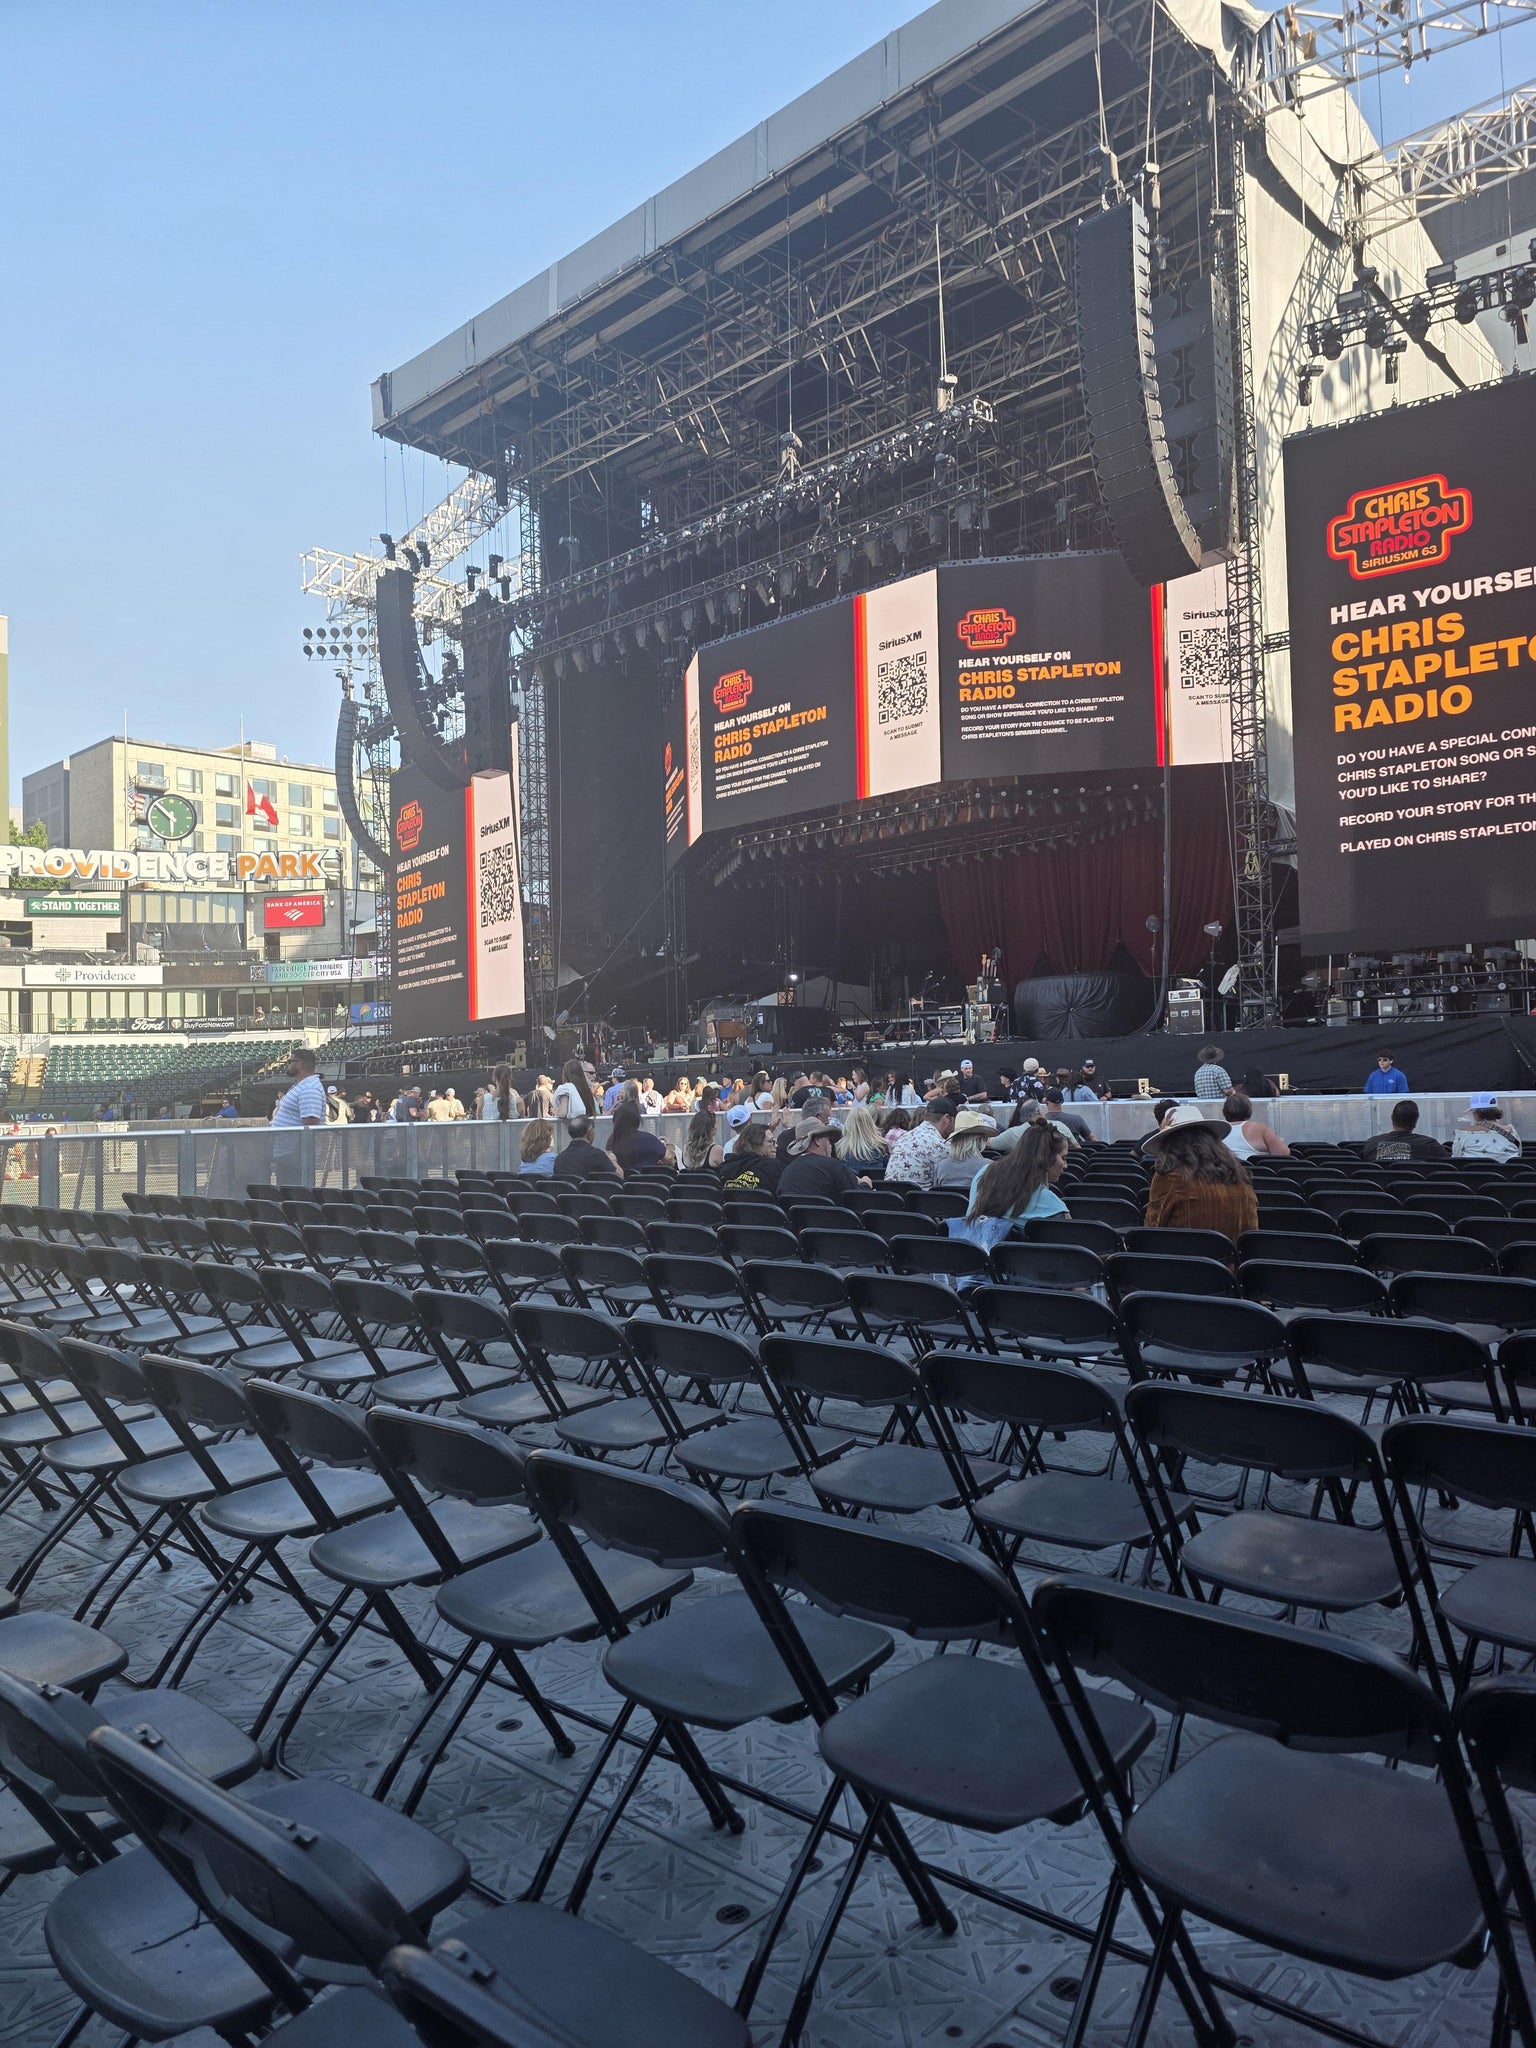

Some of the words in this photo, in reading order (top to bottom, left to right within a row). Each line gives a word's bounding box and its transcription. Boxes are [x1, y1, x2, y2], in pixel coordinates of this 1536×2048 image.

[1365, 487, 1430, 518] CHRIS
[1338, 501, 1459, 547] STAPLETON
[1370, 530, 1430, 556] RADIO
[1362, 550, 1418, 569] SIRIUSXM
[1422, 545, 1437, 556] 63
[1330, 593, 1406, 625] HEAR
[1413, 566, 1536, 608] YOURSE
[962, 621, 1011, 634] STAPLETON
[973, 613, 1000, 623] CHRIS
[878, 630, 922, 650] SiriusXM
[1332, 612, 1465, 662] CHRIS
[959, 658, 990, 668] HEAR
[992, 652, 1052, 665] YOURSELF
[1054, 651, 1071, 661] ON
[1332, 635, 1536, 696] STAPLET
[959, 669, 1013, 686] CHRIS
[1017, 661, 1121, 682] STAPLETON
[959, 685, 1016, 701] RADIO
[714, 718, 735, 732] HEAR
[736, 706, 777, 725] YOURSELF
[778, 702, 790, 714] ON
[1334, 684, 1472, 733] RADIO
[714, 727, 750, 748] CHRIS
[753, 706, 827, 738] STAPLETON
[884, 728, 897, 736] SCAN
[894, 730, 918, 739] MESSAGE
[715, 742, 752, 763] RADIO
[1337, 754, 1356, 765] DO
[1359, 749, 1385, 762] YOU
[1389, 743, 1425, 758] HAVE
[1428, 742, 1437, 752] A
[1440, 733, 1498, 750] SPECIAL
[1338, 768, 1376, 783] CHRIS
[1379, 757, 1457, 778] STAPLETON
[1460, 751, 1500, 766] SONG
[1503, 747, 1523, 759] OR
[1339, 786, 1377, 800] YOU'D
[1380, 782, 1409, 795] LIKE
[1411, 778, 1430, 790] TO
[1433, 771, 1487, 788] SHARE?
[1340, 811, 1393, 826] RECORD
[1396, 805, 1434, 820] YOUR
[1436, 799, 1483, 815] STORY
[1486, 795, 1514, 809] FOR
[1518, 792, 1536, 804] TH
[480, 816, 510, 837] SiriusXM
[1340, 838, 1391, 853] PLAYED
[1394, 835, 1414, 847] ON
[1416, 830, 1457, 845] CHRIS
[0, 845, 230, 882] PROVIDENCE
[237, 850, 327, 880] PARK
[397, 860, 411, 874] HEAR
[412, 848, 440, 868] YOURSELF
[440, 844, 449, 857] ON
[397, 870, 421, 893] CHRIS
[42, 901, 71, 911] STAND
[74, 902, 120, 911] TOGETHER
[397, 881, 445, 910] STAPLETON
[397, 908, 423, 928] RADIO
[74, 971, 136, 981] Providence
[272, 965, 306, 973] EXPERIENCE
[131, 1018, 164, 1030] Ford
[184, 1021, 234, 1029] BuyFordNow.com
